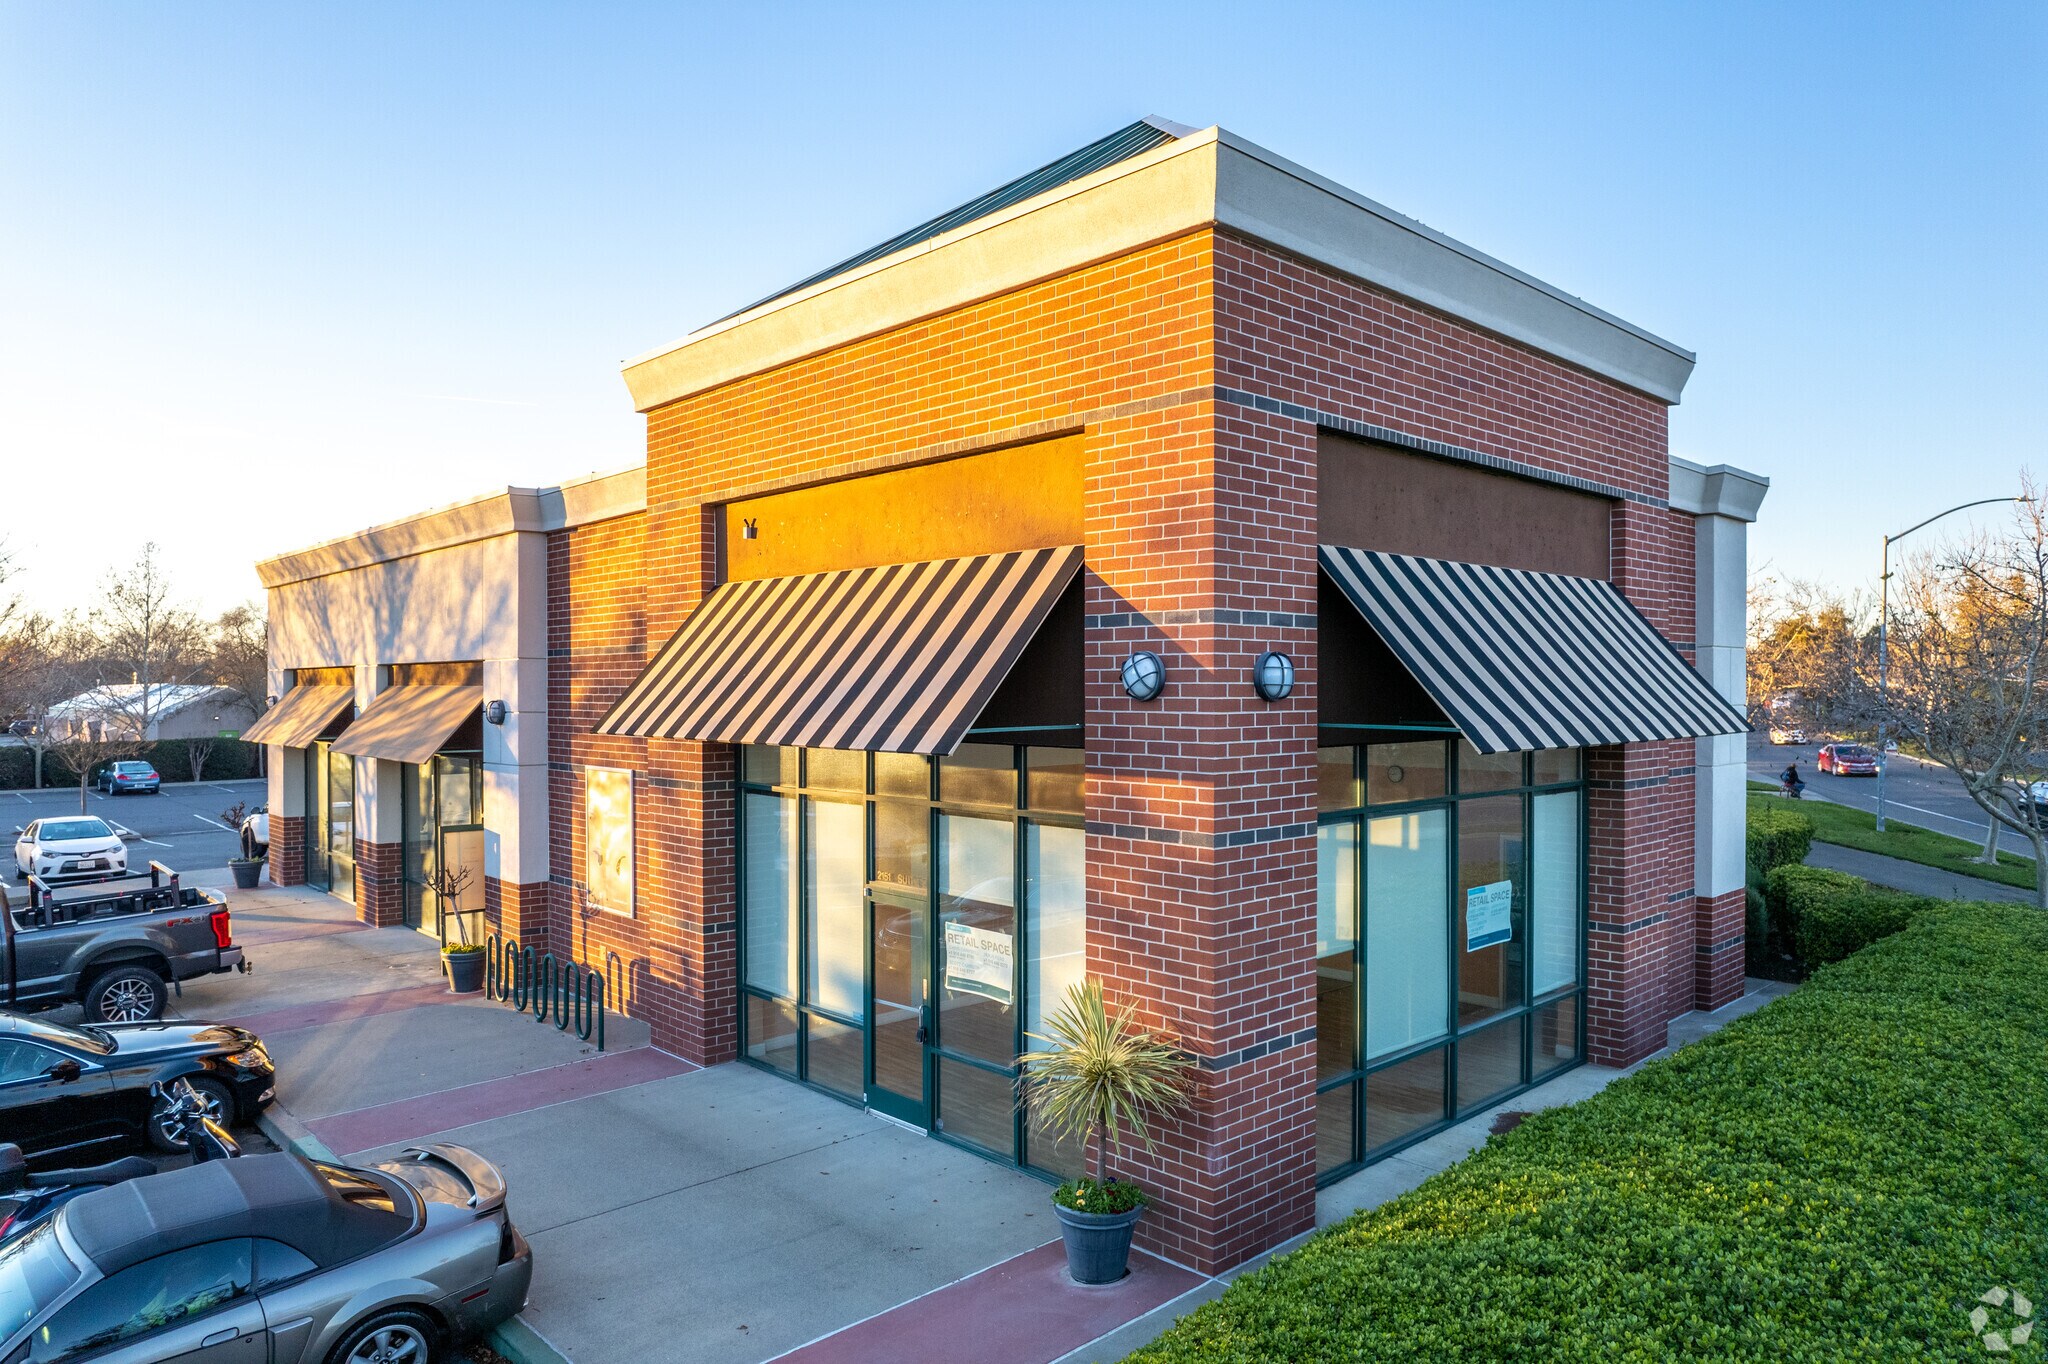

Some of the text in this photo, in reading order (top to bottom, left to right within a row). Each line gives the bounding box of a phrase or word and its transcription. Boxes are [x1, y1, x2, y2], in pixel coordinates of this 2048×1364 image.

[1469, 895, 1489, 907] RETAIL
[1491, 890, 1509, 902] SPACE
[948, 933, 978, 949] RETAIL
[981, 940, 1010, 956] SPACE
